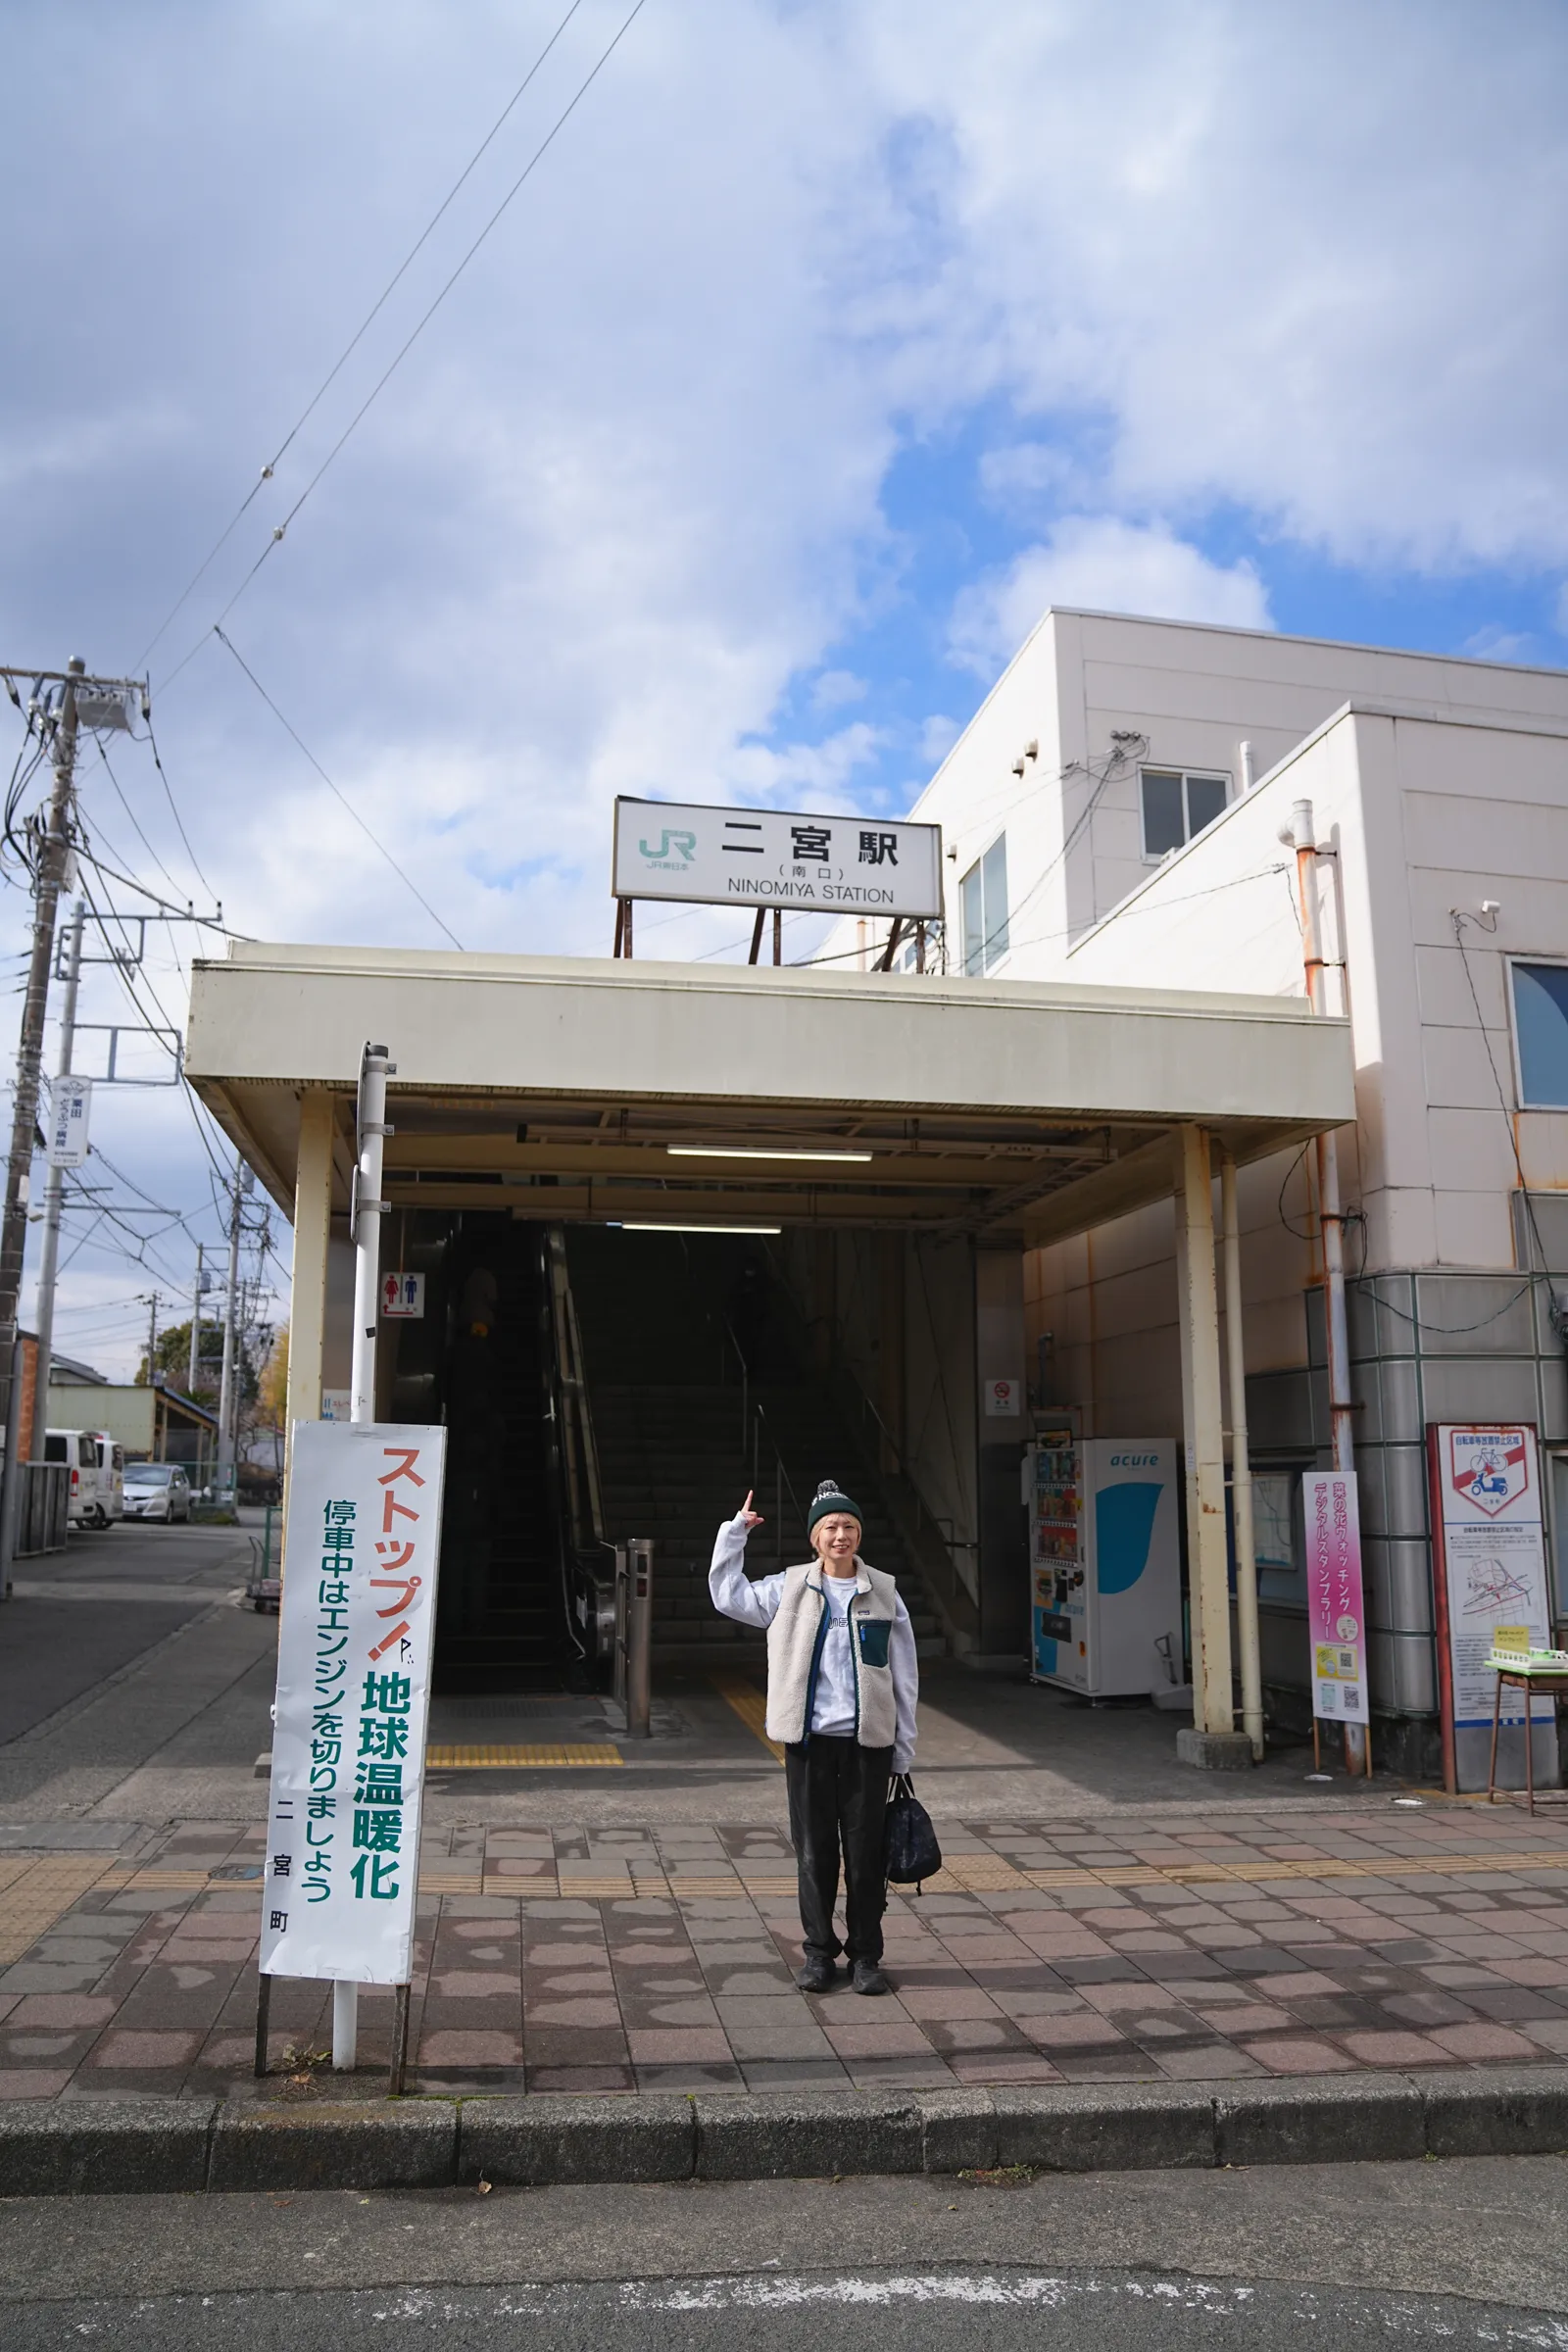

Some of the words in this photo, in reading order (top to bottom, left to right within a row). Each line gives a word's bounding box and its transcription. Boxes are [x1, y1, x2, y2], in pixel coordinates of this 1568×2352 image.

[639, 829, 697, 861] JR
[721, 821, 899, 866] 二宮駅
[728, 878, 815, 898] NINOMIYA
[822, 884, 894, 904] STATION
[779, 864, 844, 881] (南口)
[1110, 1455, 1158, 1467] acure
[1314, 1482, 1331, 1639] デジタルスタンプラリー
[1333, 1482, 1350, 1612] 菜の花ウォッチング
[302, 1499, 357, 1902] 停車中はエンジンを切りましょう
[270, 1800, 294, 1933] 二宮町
